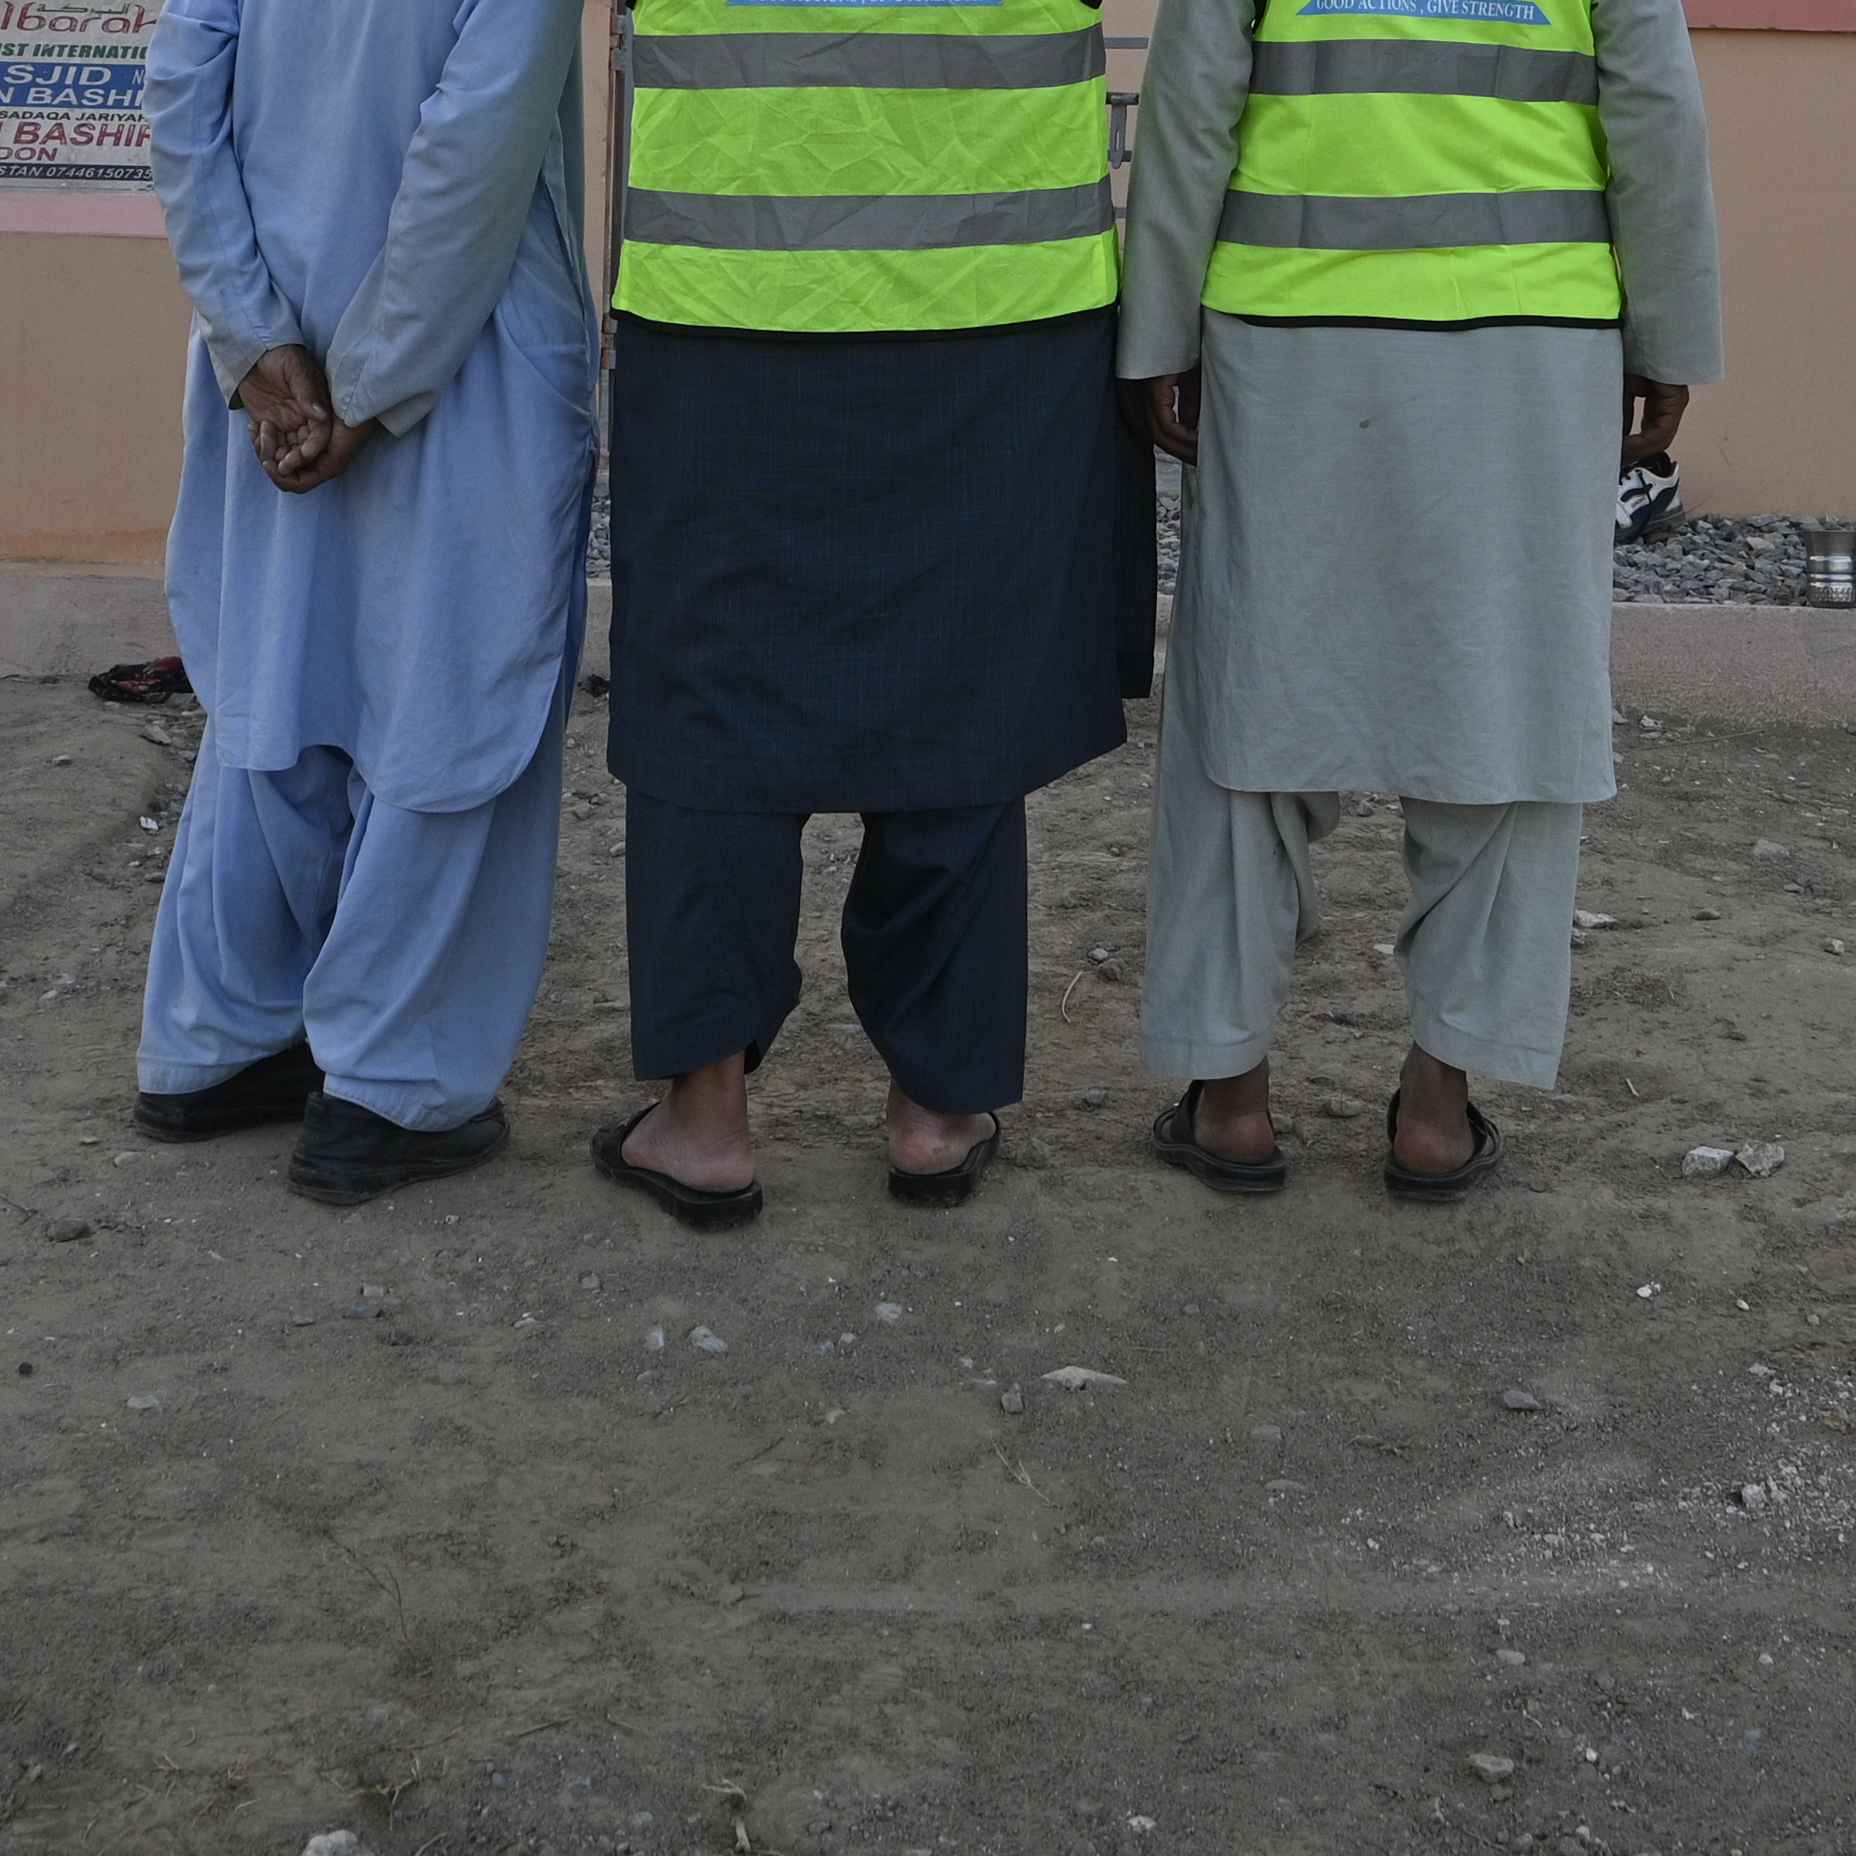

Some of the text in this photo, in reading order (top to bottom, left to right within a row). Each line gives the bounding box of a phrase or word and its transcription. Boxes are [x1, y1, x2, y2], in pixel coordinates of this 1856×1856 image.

[1427, 0, 1458, 14] GIVE
[1461, 1, 1535, 21] STRENGTH
[32, 44, 148, 60] INTERNATI
[26, 87, 145, 107] BASHI
